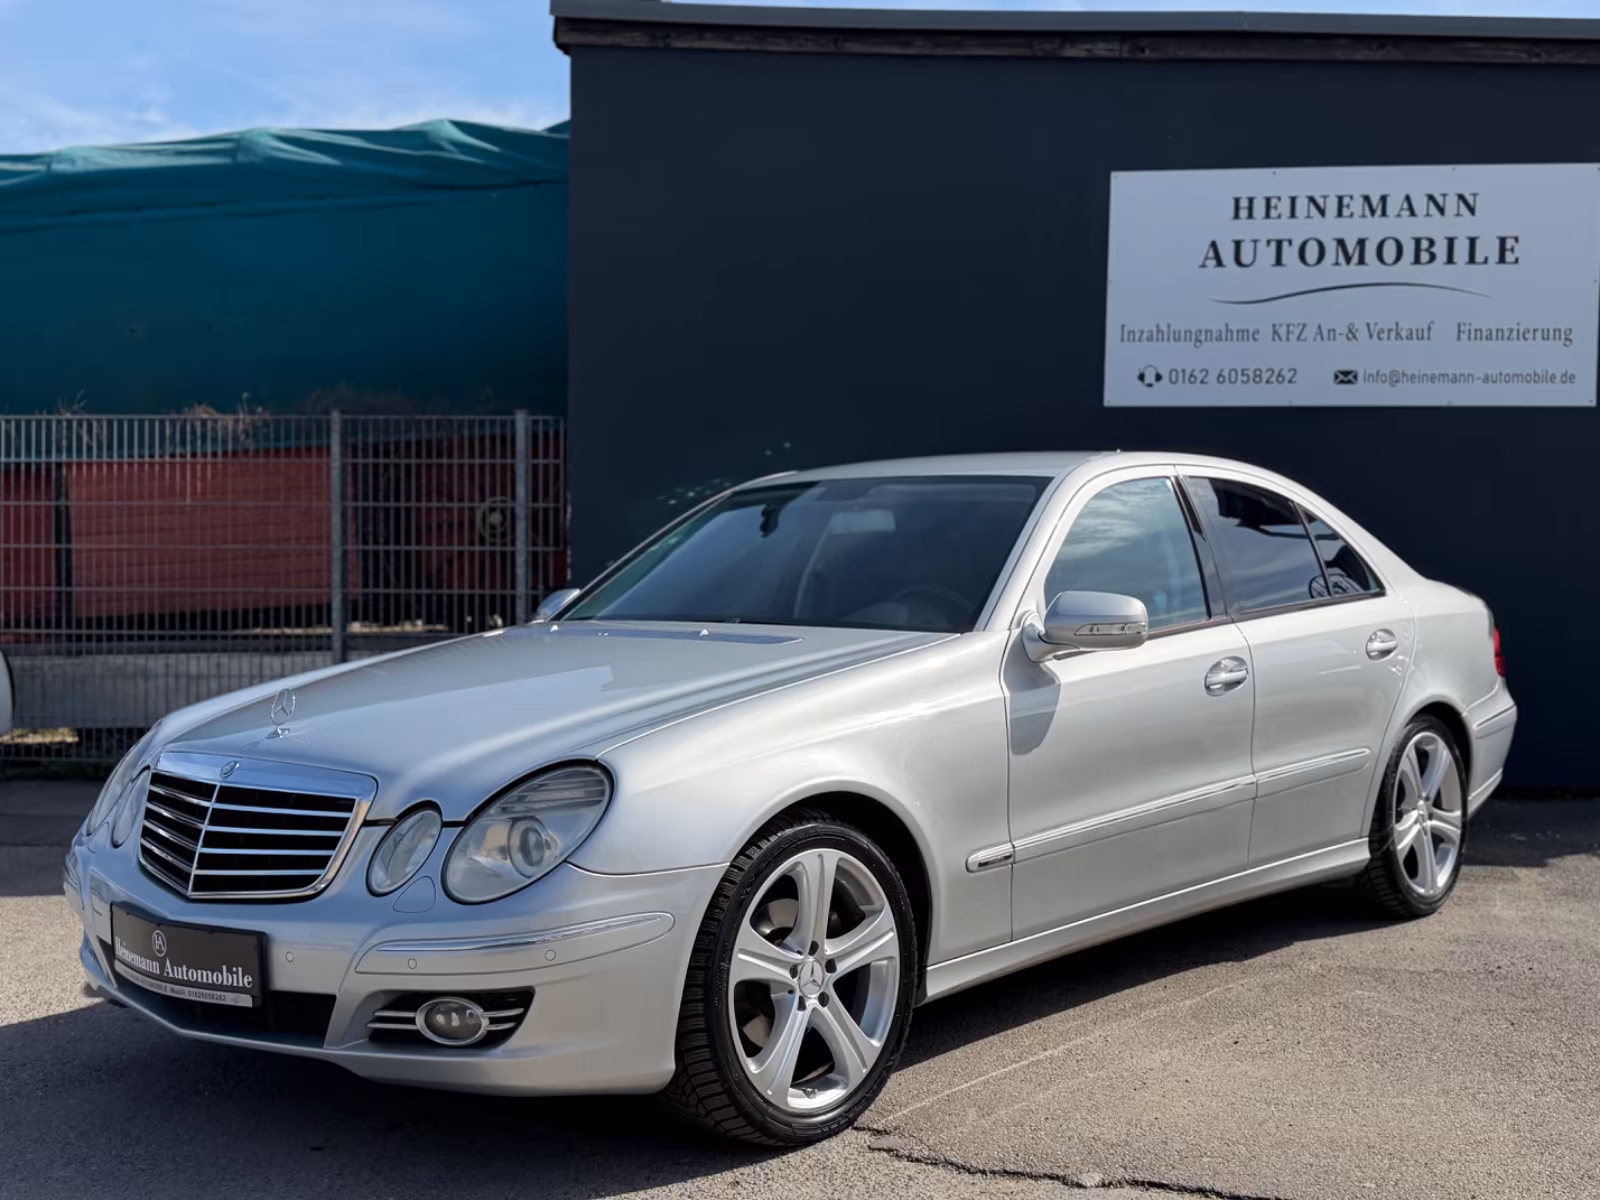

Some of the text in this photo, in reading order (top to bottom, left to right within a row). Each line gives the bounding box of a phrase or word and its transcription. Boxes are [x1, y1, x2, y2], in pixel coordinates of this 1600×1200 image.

[1231, 193, 1479, 220] HEINEMANN
[1199, 236, 1520, 268] AUTOMOBILE
[1120, 323, 1260, 348] Inzahlungnahme
[1272, 322, 1307, 342] KFZ
[1366, 321, 1434, 342] Verkauf
[1456, 321, 1573, 347] Finanzierung
[1168, 367, 1298, 385] 0162 6058262
[1363, 369, 1576, 387] Info@heinemann-automobile.de
[115, 936, 160, 974] Heinemann
[163, 956, 252, 988] Automobile
